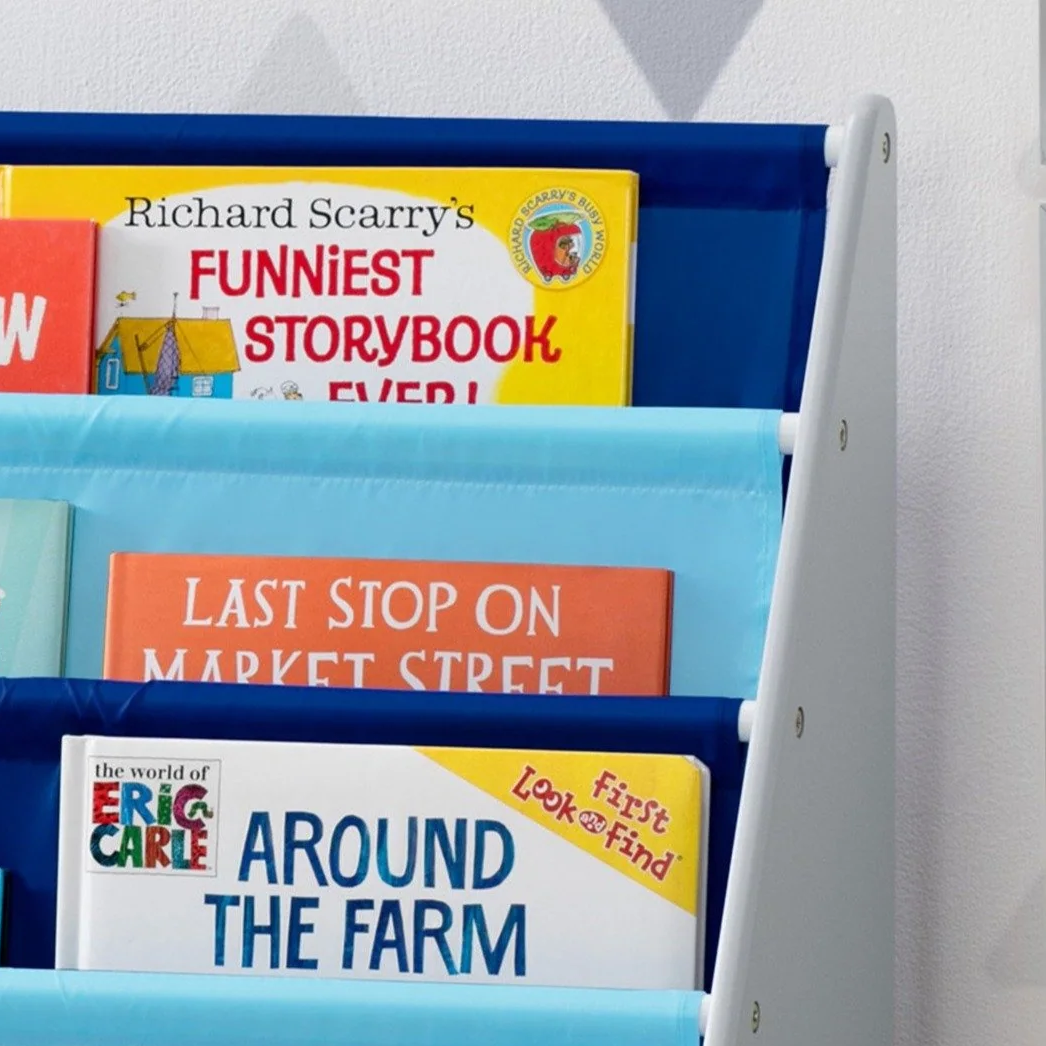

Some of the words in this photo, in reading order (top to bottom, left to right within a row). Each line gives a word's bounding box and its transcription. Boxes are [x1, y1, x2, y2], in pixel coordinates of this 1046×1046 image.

[125, 197, 295, 228] Richard
[309, 196, 475, 236] Scarry's
[521, 188, 576, 217] SCARRY'S
[578, 197, 602, 225] BUSY
[511, 217, 531, 274] RICHARD
[582, 229, 605, 274] WORLD
[182, 577, 306, 629] LAST
[328, 576, 458, 634] STOP
[475, 584, 562, 638] ON
[143, 648, 375, 690] MARKET
[399, 649, 614, 696] STREET
[95, 762, 124, 778] the
[131, 764, 184, 780] world
[190, 765, 210, 781] of
[511, 765, 577, 824] Look
[580, 812, 606, 832] and
[89, 823, 208, 870] CARLE
[238, 810, 516, 891] AROUND
[204, 894, 320, 970] THE
[341, 899, 527, 977] FARM
